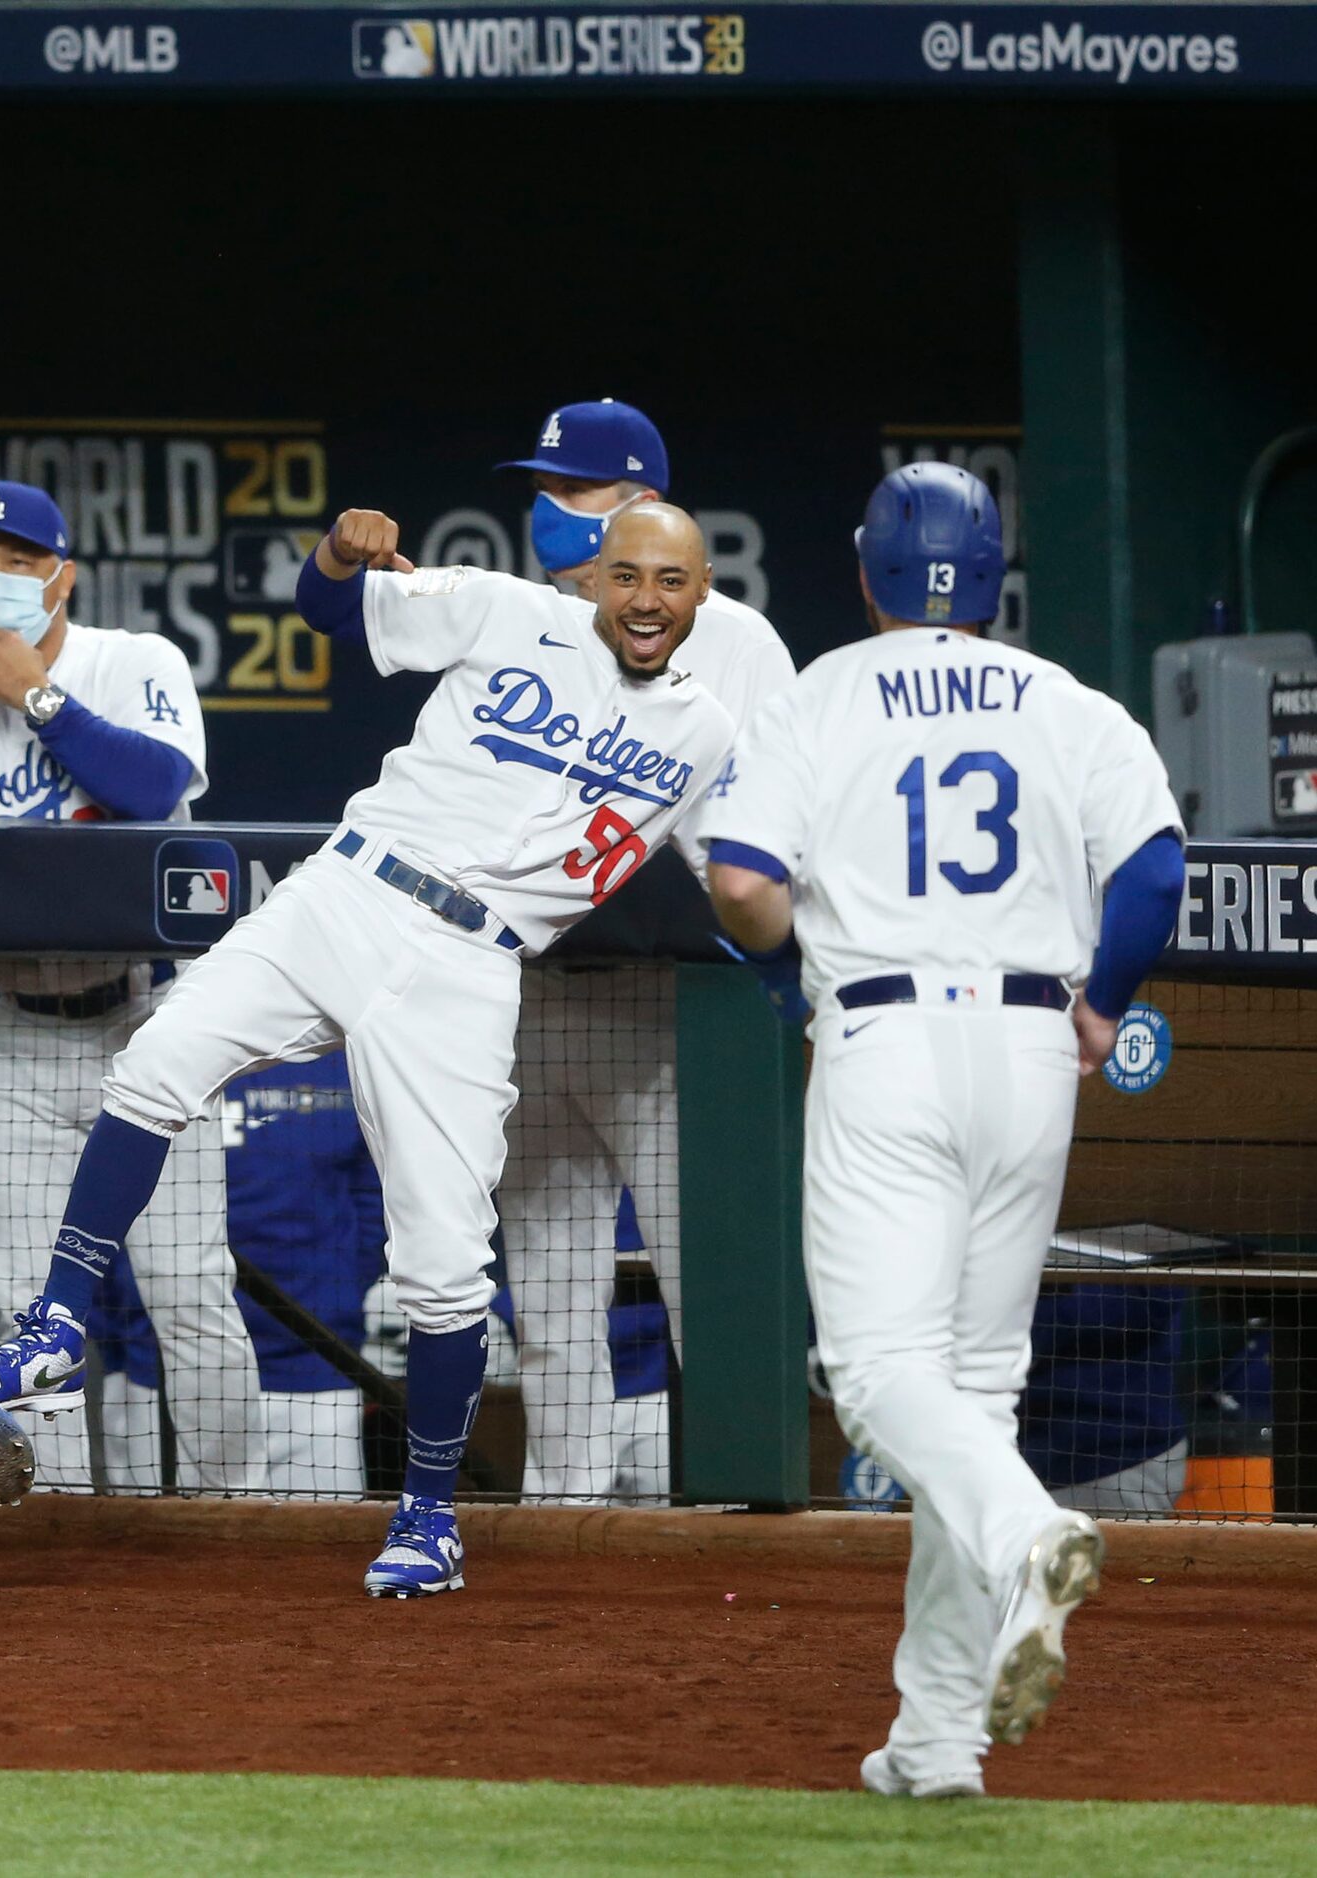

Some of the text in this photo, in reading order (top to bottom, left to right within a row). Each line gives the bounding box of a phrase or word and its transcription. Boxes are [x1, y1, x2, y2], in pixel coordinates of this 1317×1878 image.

[44, 25, 179, 73] @MLB
[438, 16, 702, 77] WORLD SERIES
[705, 15, 744, 44] 20
[705, 46, 744, 74] 20
[922, 21, 1238, 84] @LasMayores
[225, 441, 327, 518] 20
[928, 562, 956, 594] 13
[227, 613, 332, 691] 20
[145, 678, 182, 726] LA
[877, 666, 1033, 719] MUNCY
[474, 667, 693, 805] Dodgers
[896, 751, 1018, 896] 13
[562, 804, 648, 907] 50
